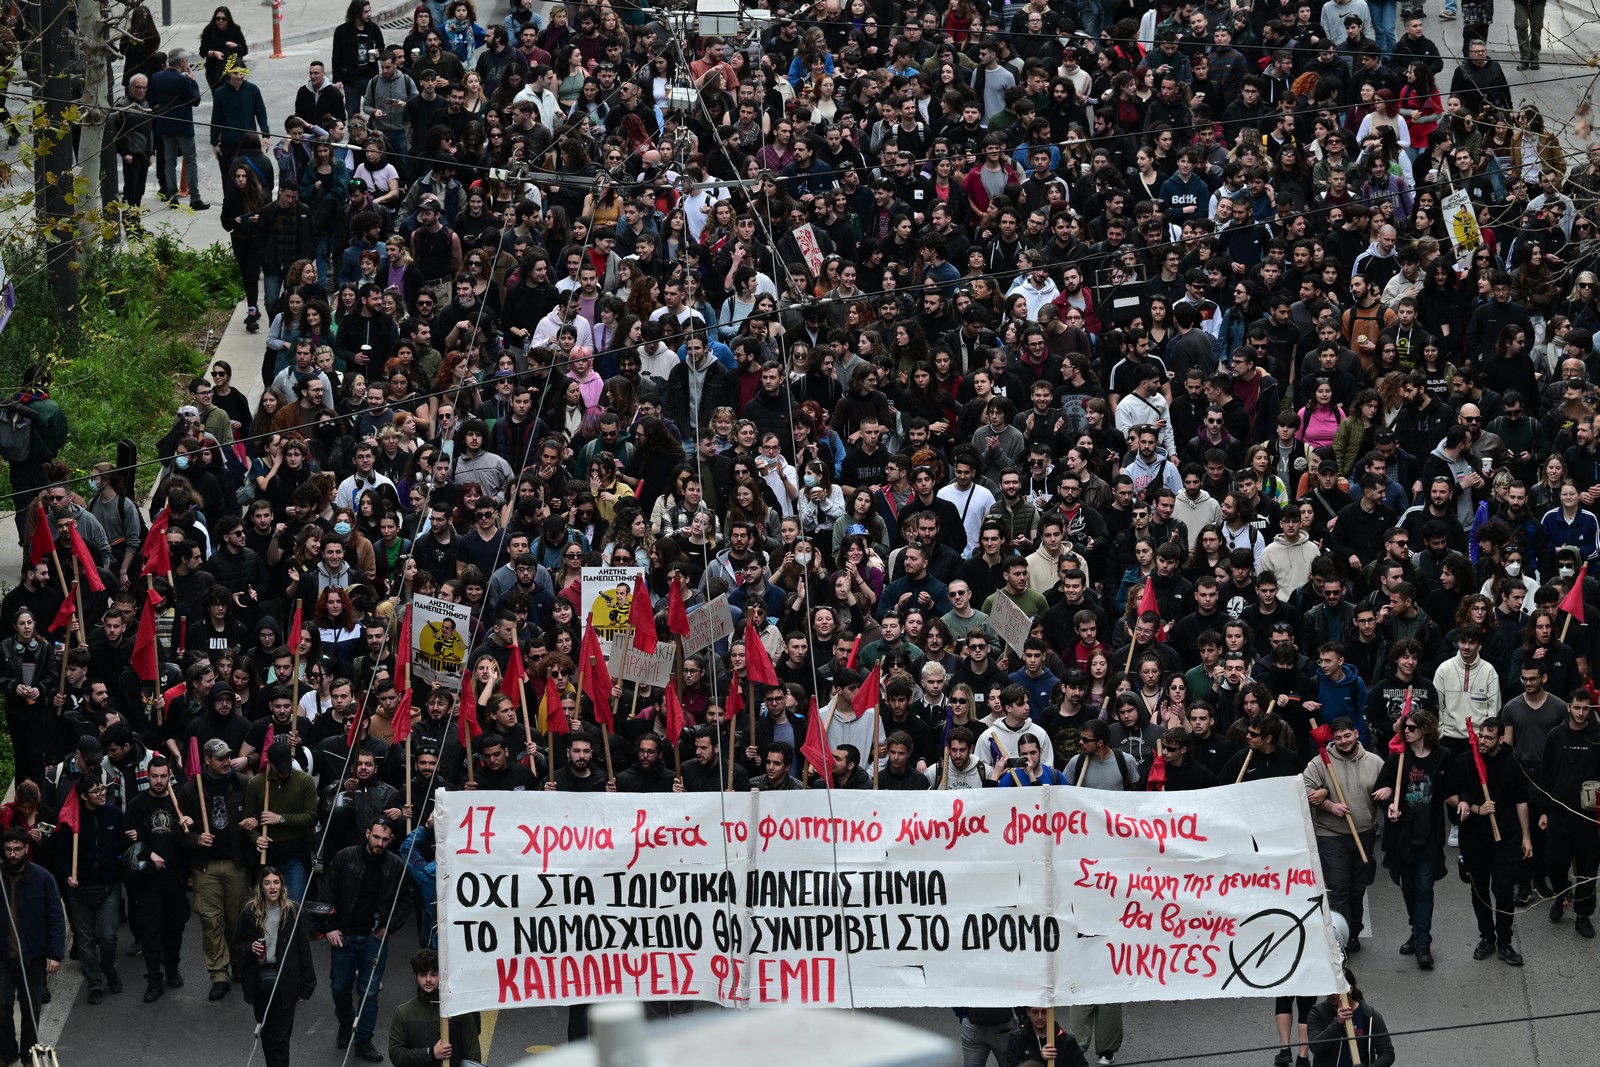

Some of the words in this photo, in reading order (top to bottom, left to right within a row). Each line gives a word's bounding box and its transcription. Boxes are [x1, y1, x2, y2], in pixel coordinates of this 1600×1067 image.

[414, 601, 468, 620] ΠΑΝΕΠΙΣΤΗΜΙΟΥ
[428, 600, 455, 611] ΛΗΣΤΗΣ
[456, 806, 496, 854] 17
[627, 809, 708, 870] μετά
[720, 820, 748, 843] το
[758, 810, 882, 852] φοιτητικό
[895, 798, 989, 850] κίνημα
[1003, 803, 1088, 845] γράφει
[456, 871, 519, 909] ΟΧΙ
[535, 873, 595, 909] ΣΤΑ
[603, 870, 737, 909] ΙΔΙΩΤΙΚΑ
[746, 869, 947, 908] ΠΑΝΕΠΙΣΤΗΜΙΑ
[1074, 858, 1118, 898] Στη
[1126, 866, 1179, 901] μάχη
[1183, 873, 1214, 899] της
[1218, 866, 1281, 896] γενιάς
[453, 920, 498, 952] ΤΟ
[513, 912, 703, 955] ΝΟΜΟΣΧΕΔΙΟ
[712, 909, 742, 954] ΘΑ
[749, 913, 890, 955] ΣΥΝΤΡΙΒΕΙ
[896, 913, 950, 951] ΣΤΟ
[962, 913, 1060, 952] ΔΡΟΜΟ
[1161, 903, 1237, 942] βγούμε
[496, 951, 700, 1003] ΚΑΤΑΛΗΨΕΙΣ
[758, 957, 835, 1004] ΕΜΠ
